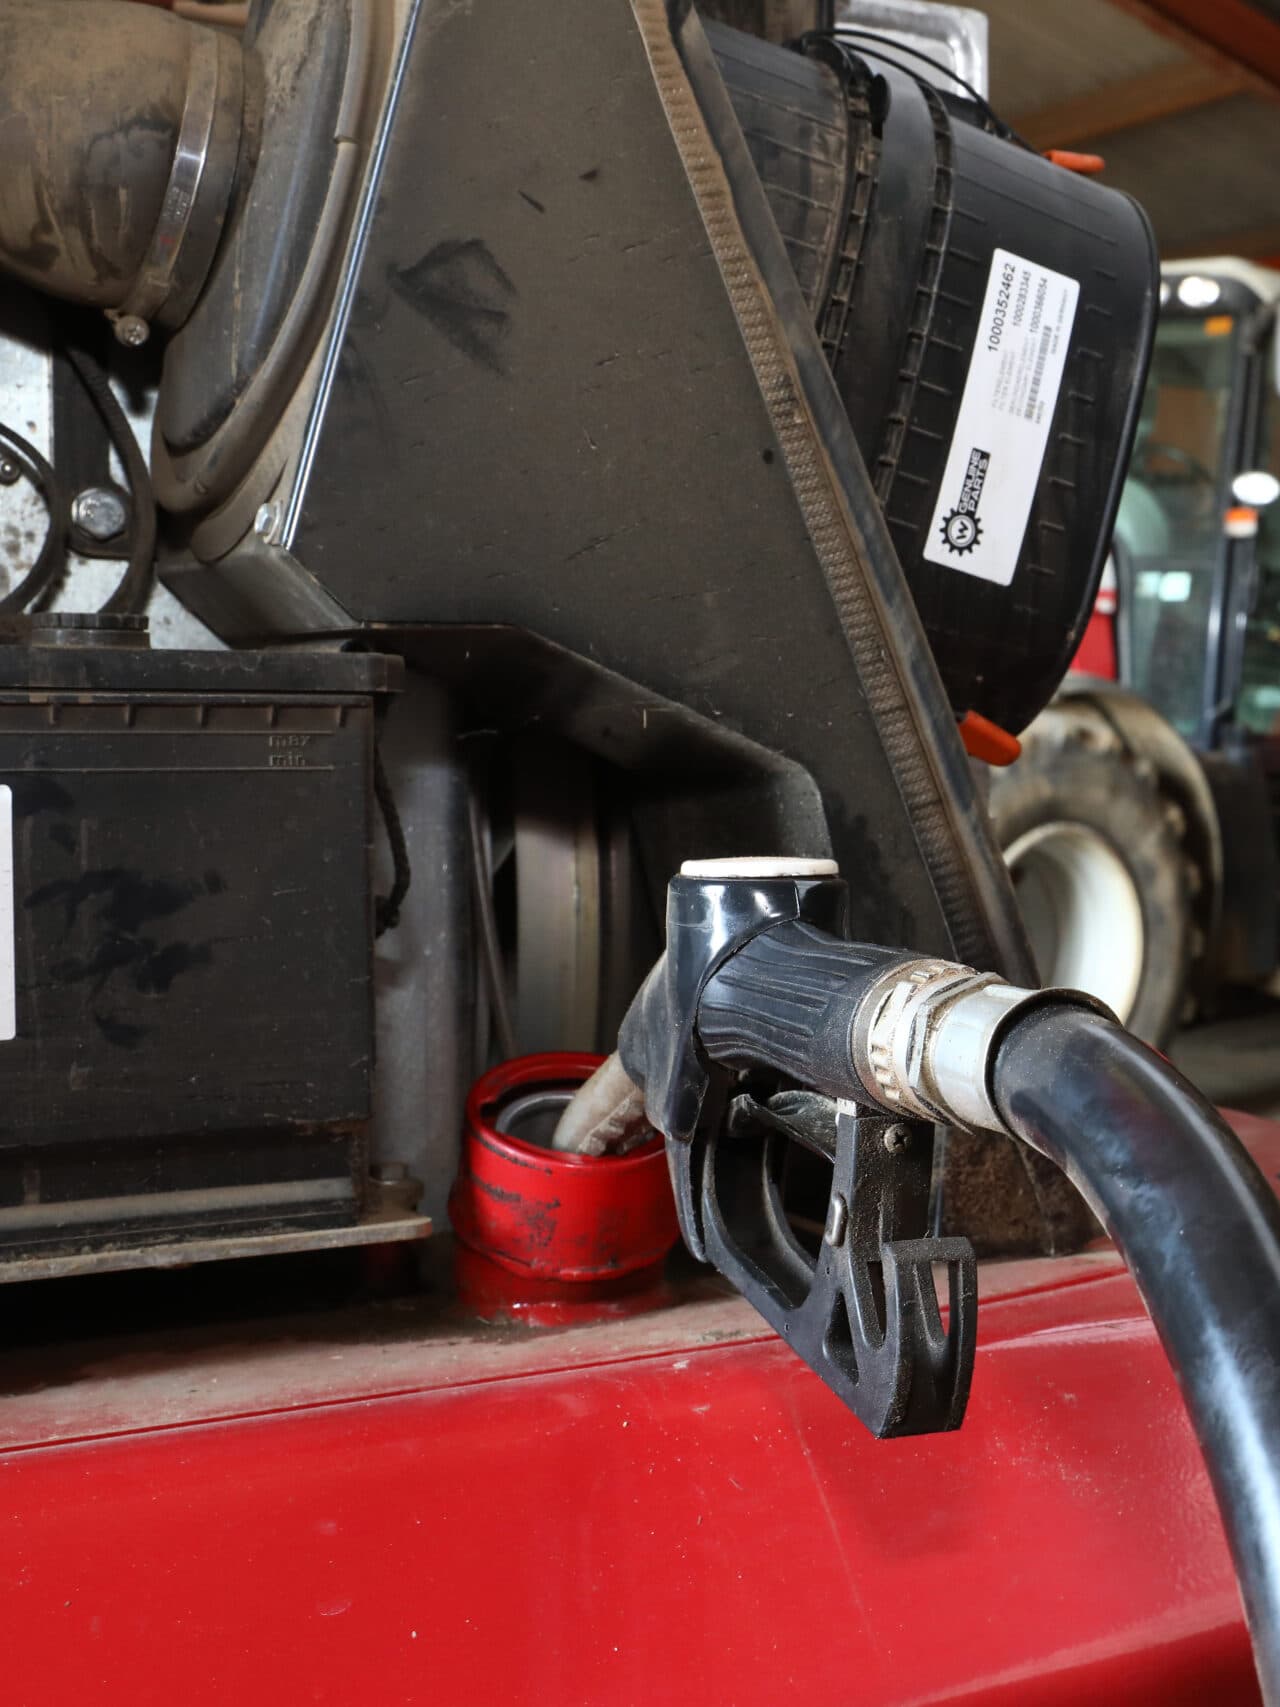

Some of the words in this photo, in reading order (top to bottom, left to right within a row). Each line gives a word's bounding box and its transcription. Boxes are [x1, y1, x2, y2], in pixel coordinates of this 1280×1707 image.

[987, 263, 1015, 352] 1000352462
[959, 450, 981, 513] GENUINE
[968, 459, 988, 511] PARTS
[269, 735, 310, 747] max
[269, 752, 306, 767] min
